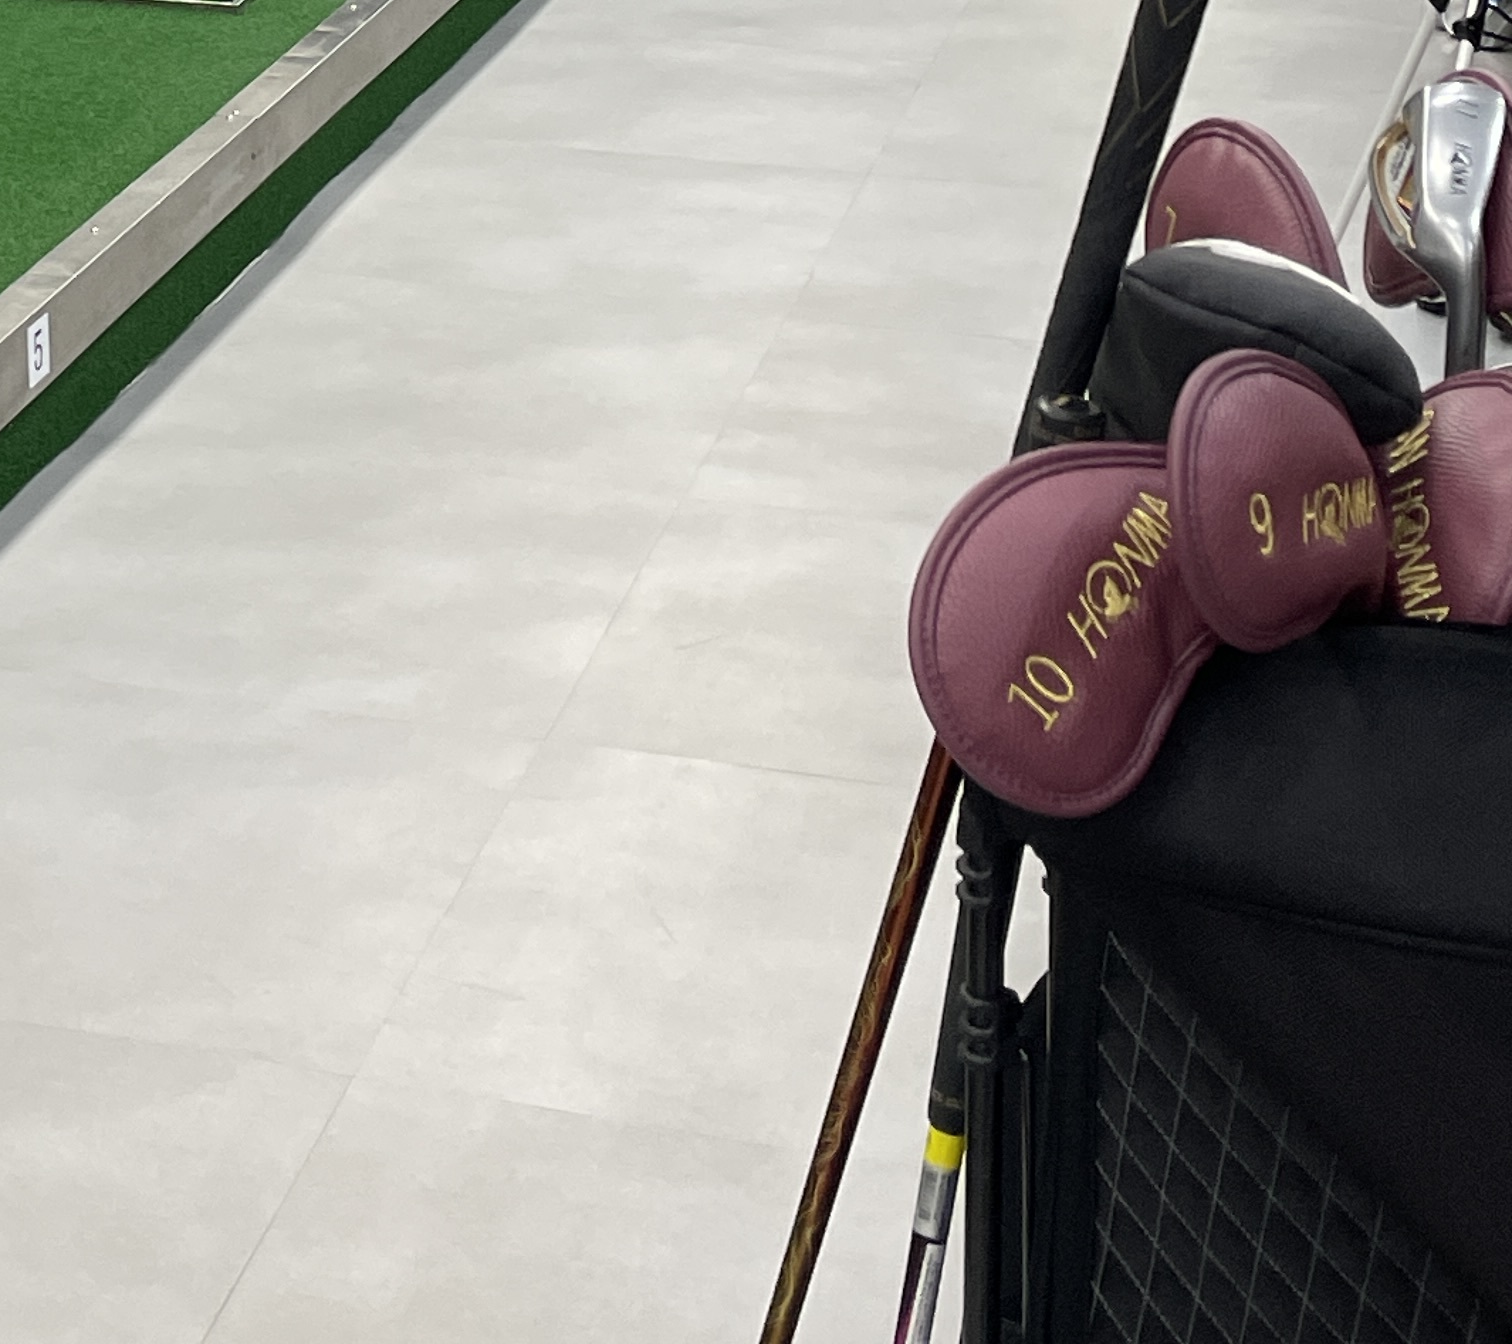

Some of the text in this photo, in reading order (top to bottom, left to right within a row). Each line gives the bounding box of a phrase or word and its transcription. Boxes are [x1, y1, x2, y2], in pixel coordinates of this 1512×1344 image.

[33, 328, 44, 372] 5
[1249, 492, 1275, 556] 9
[1006, 491, 1172, 732] 10 HONMA
